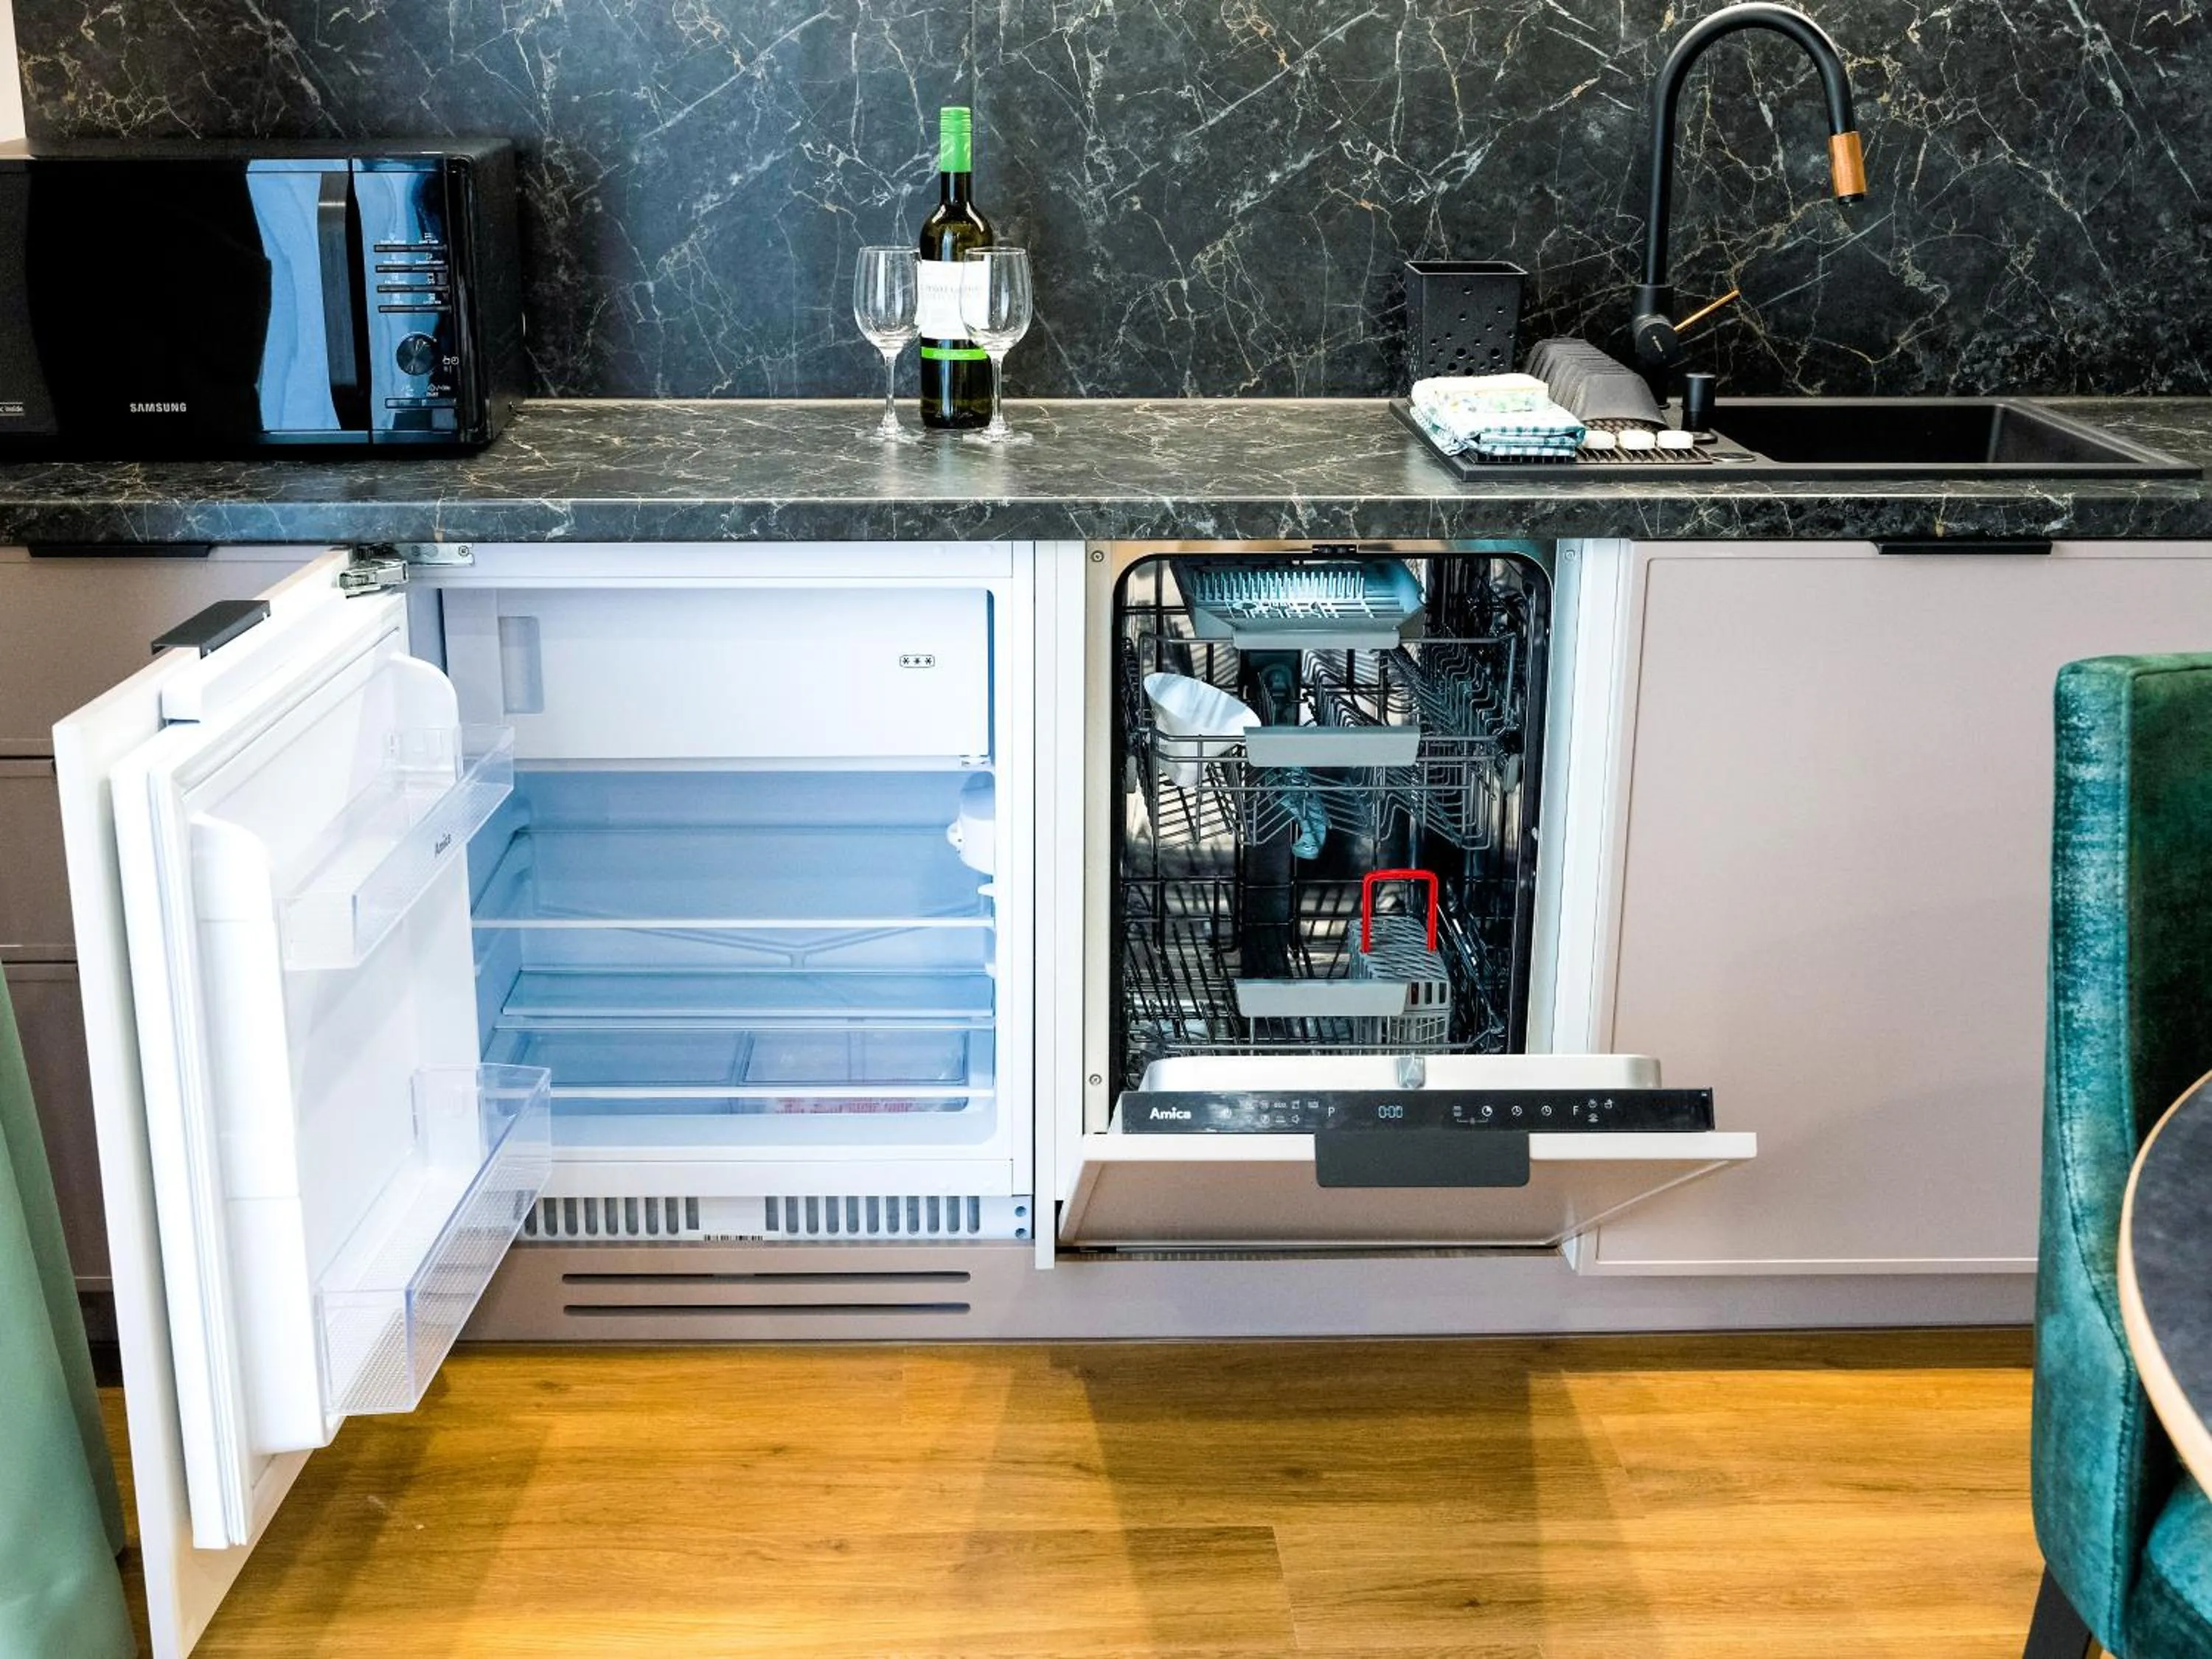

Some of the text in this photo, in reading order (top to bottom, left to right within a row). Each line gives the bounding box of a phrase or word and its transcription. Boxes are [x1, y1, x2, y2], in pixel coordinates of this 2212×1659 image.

[130, 402, 187, 413] SAMSUNG
[1150, 1106, 1192, 1119] Amica
[1573, 1105, 1579, 1116] F
